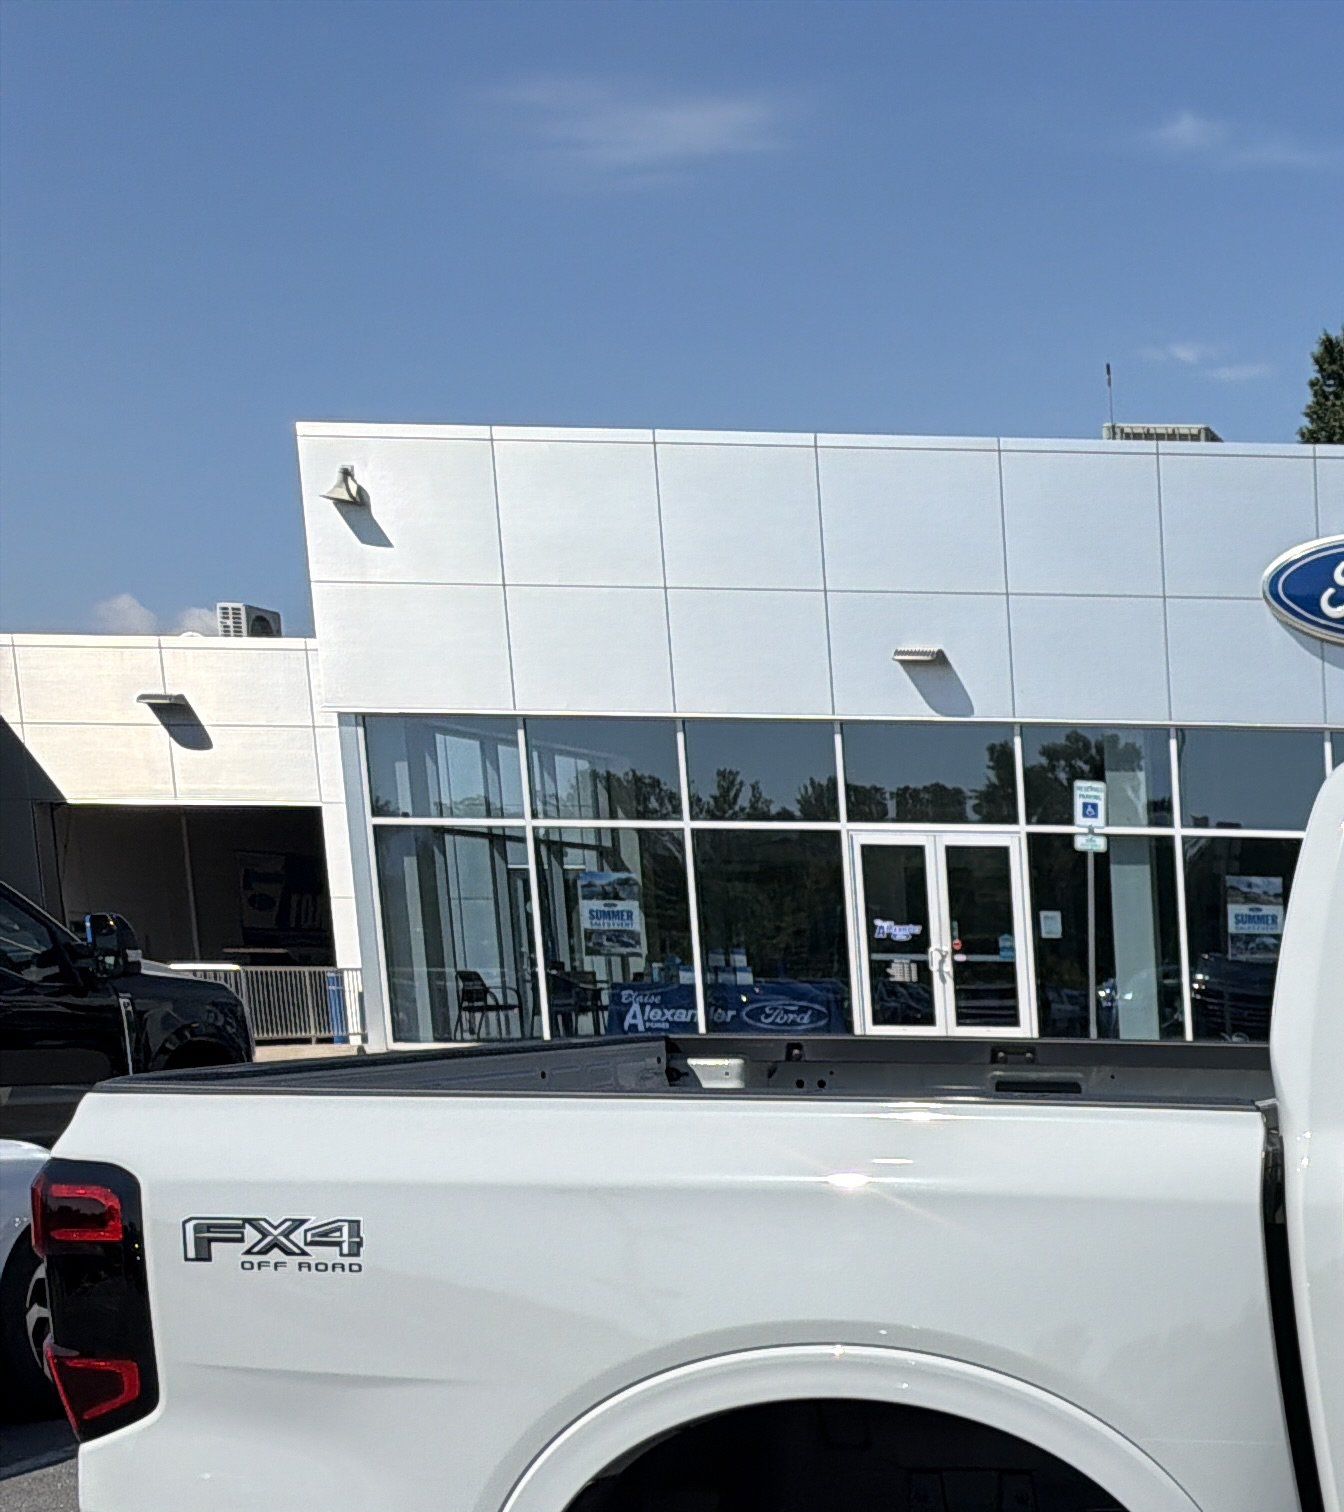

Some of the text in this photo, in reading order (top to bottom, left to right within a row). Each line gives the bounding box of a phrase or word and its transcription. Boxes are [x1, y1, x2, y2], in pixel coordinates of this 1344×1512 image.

[589, 908, 634, 921] SUMMER
[1234, 913, 1279, 925] SUMMER
[760, 1005, 813, 1024] Ford
[182, 1216, 364, 1263] FX4
[241, 1260, 363, 1273] OFF ROAD
